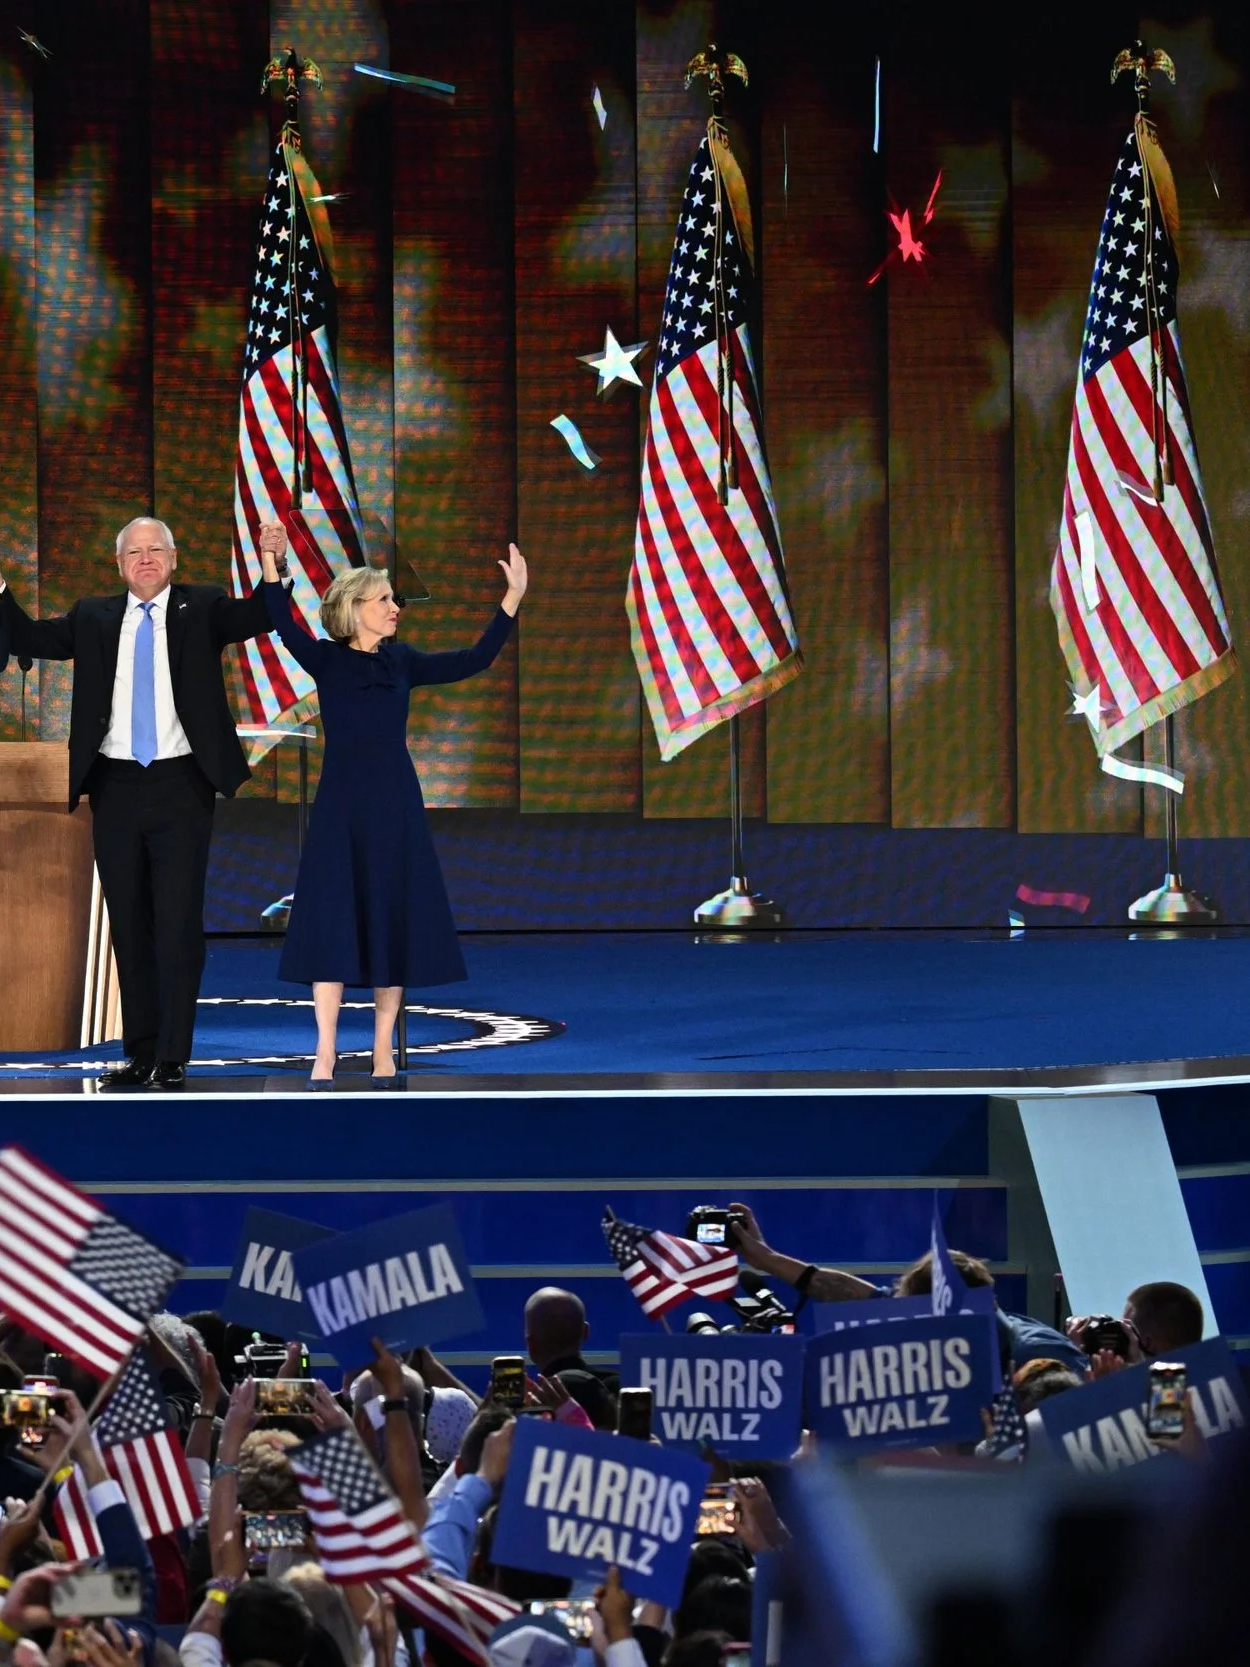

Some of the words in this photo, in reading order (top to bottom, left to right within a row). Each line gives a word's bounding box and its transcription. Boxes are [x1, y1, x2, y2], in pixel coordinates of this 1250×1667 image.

[239, 1242, 302, 1303] KA
[306, 1243, 465, 1337] KAMALA
[640, 1357, 783, 1409] HARRIS
[820, 1337, 972, 1408] HARRIS
[661, 1412, 761, 1441] WALZ
[842, 1394, 950, 1438] WALZ
[1062, 1376, 1244, 1474] KAMLA
[524, 1445, 690, 1543] HARRIS
[547, 1515, 660, 1576] WALZ
